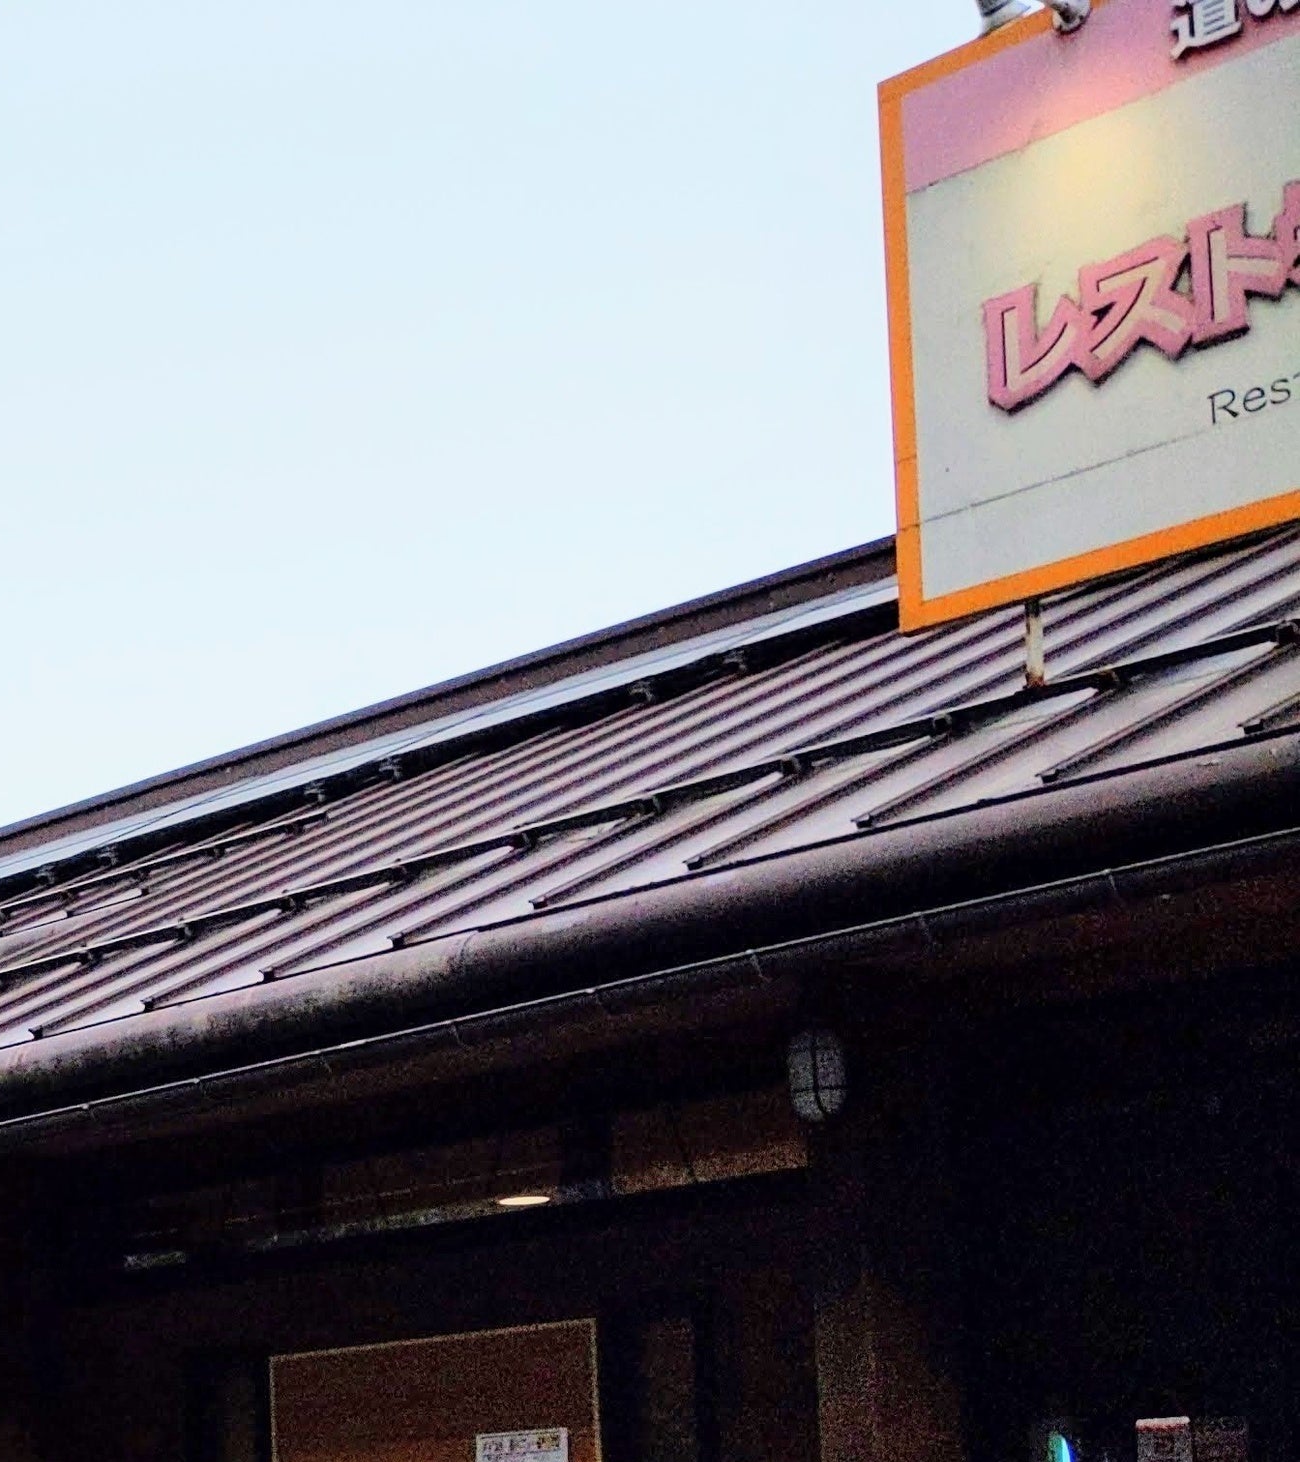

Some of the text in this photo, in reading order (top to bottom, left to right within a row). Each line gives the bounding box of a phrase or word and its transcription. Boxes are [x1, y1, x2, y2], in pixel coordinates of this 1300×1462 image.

[1169, 0, 1300, 61] 道
[985, 180, 1300, 416] レスト
